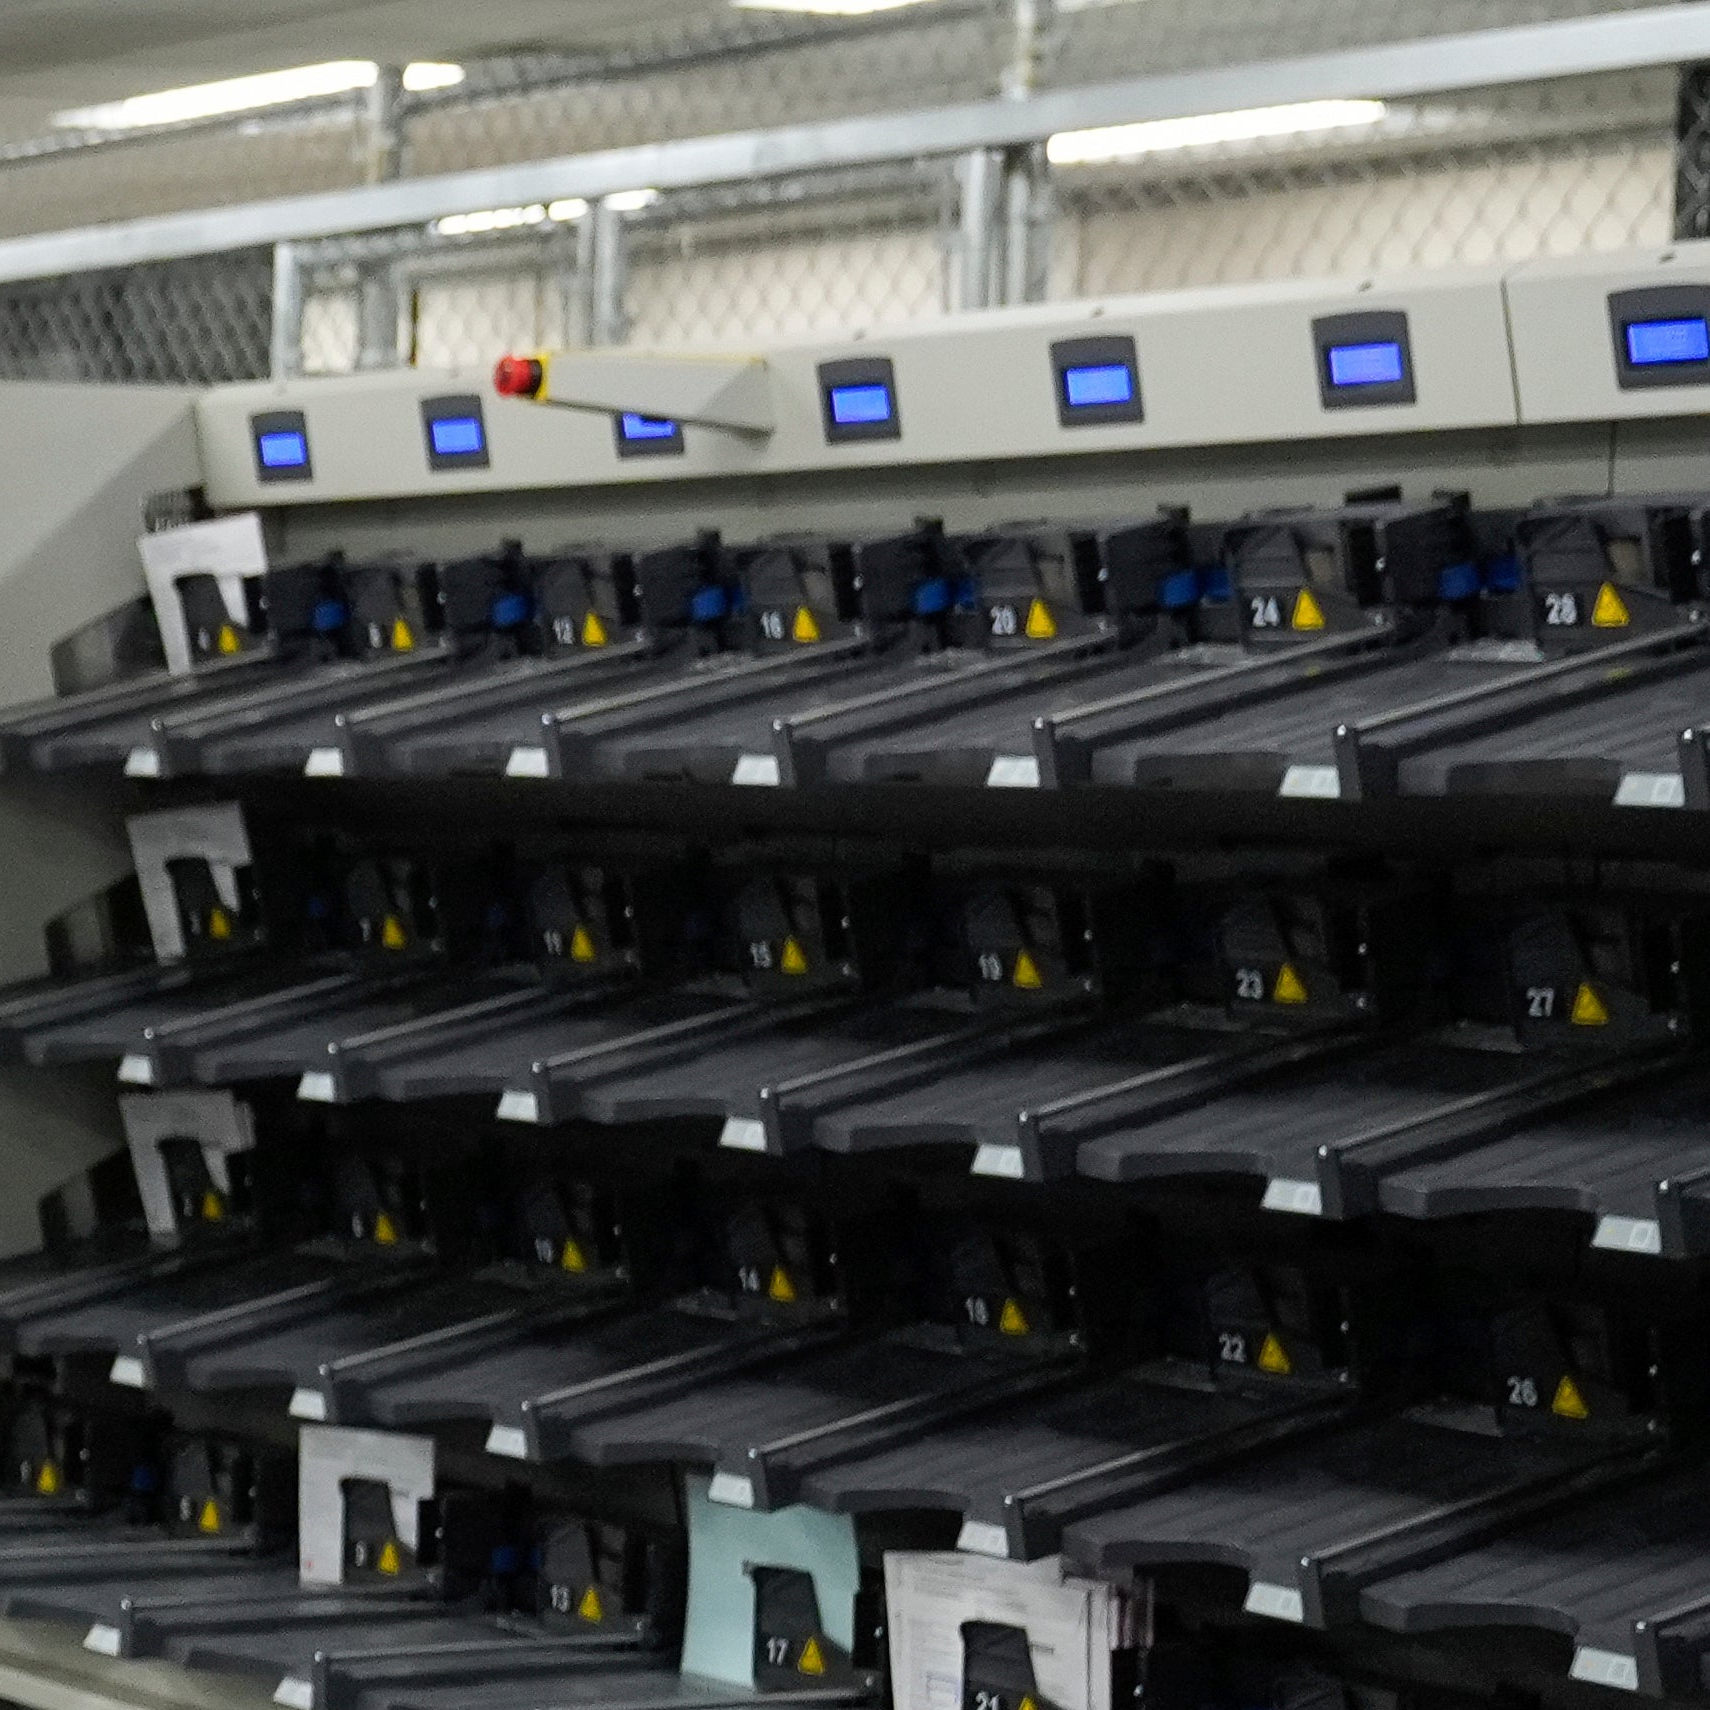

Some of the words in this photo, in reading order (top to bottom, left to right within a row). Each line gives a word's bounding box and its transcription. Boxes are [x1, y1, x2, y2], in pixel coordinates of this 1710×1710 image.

[1251, 596, 1280, 627] 24
[1545, 593, 1578, 624] 28
[1236, 969, 1263, 999] 23
[1526, 987, 1554, 1016] 27
[1219, 1332, 1245, 1362] 22
[767, 1637, 789, 1666] 17
